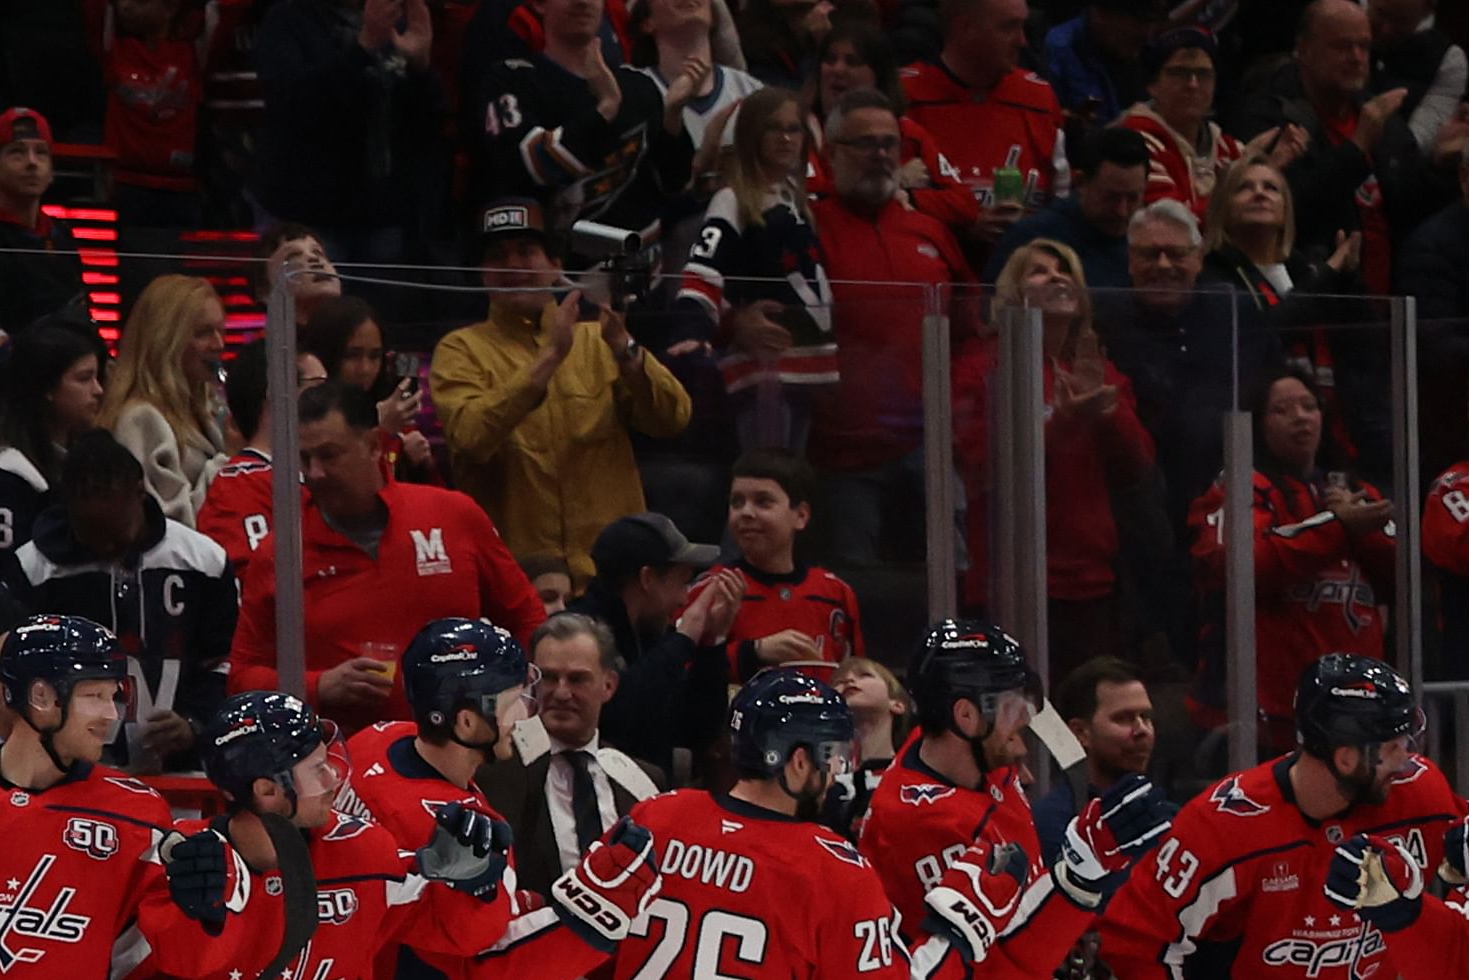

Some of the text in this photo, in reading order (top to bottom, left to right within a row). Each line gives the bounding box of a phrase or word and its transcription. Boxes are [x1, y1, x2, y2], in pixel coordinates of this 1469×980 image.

[689, 225, 722, 260] 3
[409, 527, 450, 562] M
[163, 574, 185, 616] C
[67, 819, 116, 845] 50
[661, 840, 754, 893] DOWD
[1155, 837, 1201, 898] 43
[551, 877, 622, 932] CCM
[854, 917, 893, 972] 26
